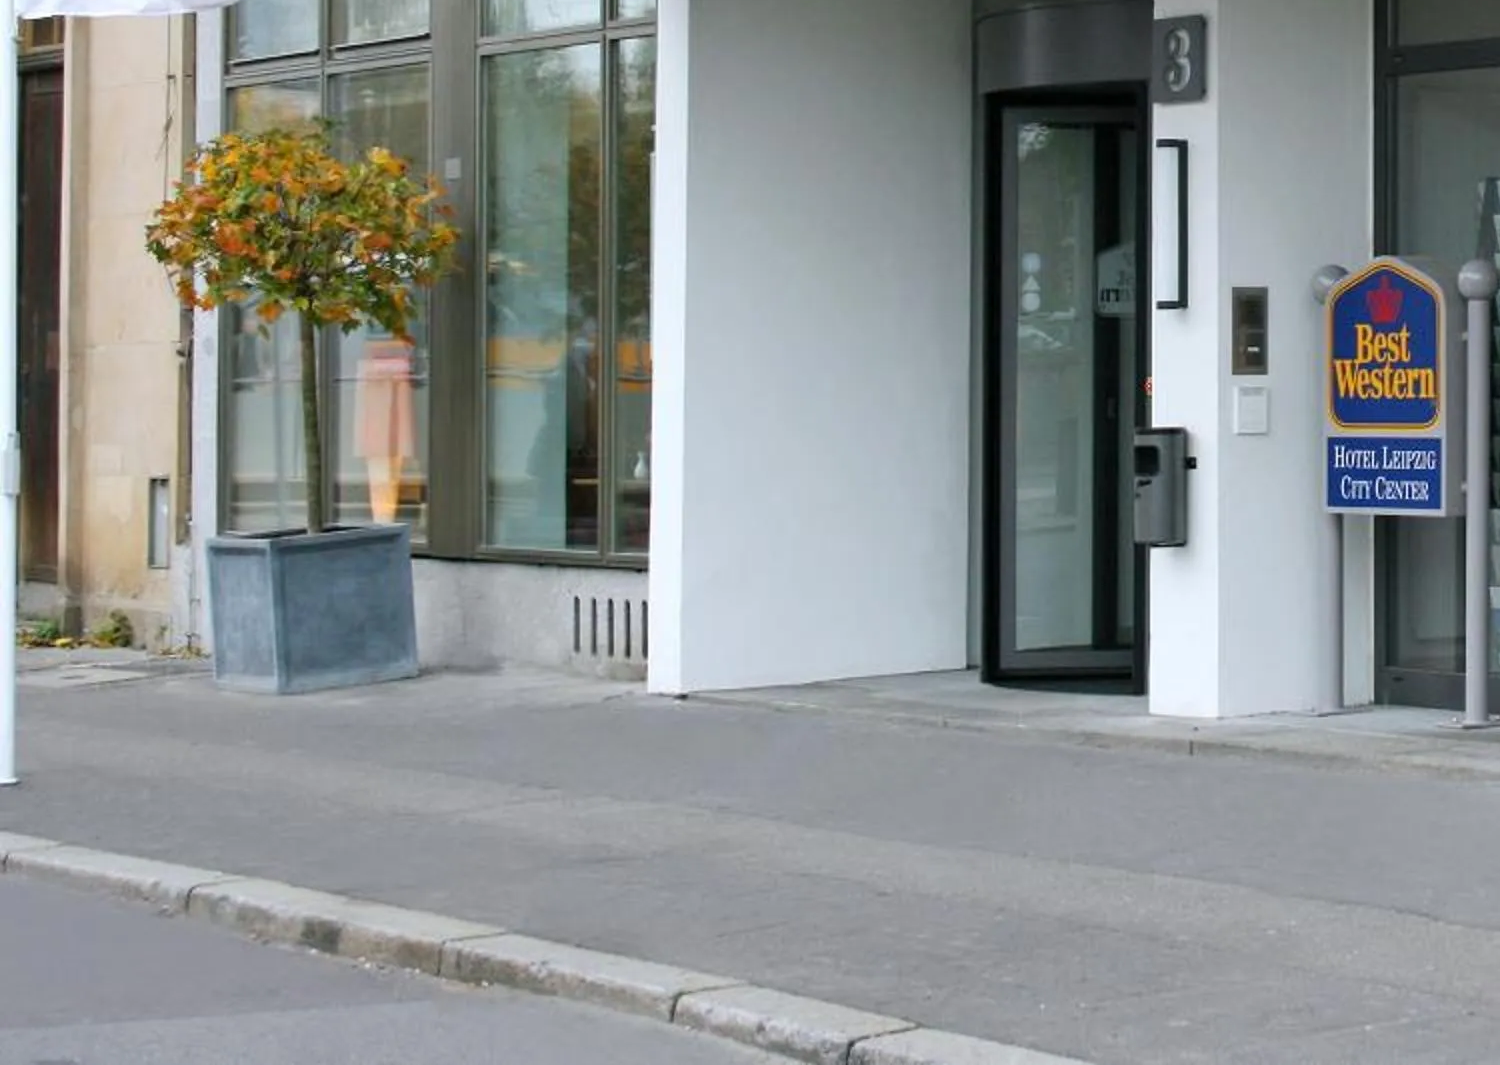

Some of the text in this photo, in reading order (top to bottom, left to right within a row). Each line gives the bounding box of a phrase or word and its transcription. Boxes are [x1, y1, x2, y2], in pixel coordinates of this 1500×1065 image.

[1165, 28, 1191, 93] 3
[1354, 322, 1411, 364] Best
[1333, 358, 1437, 400] Western
